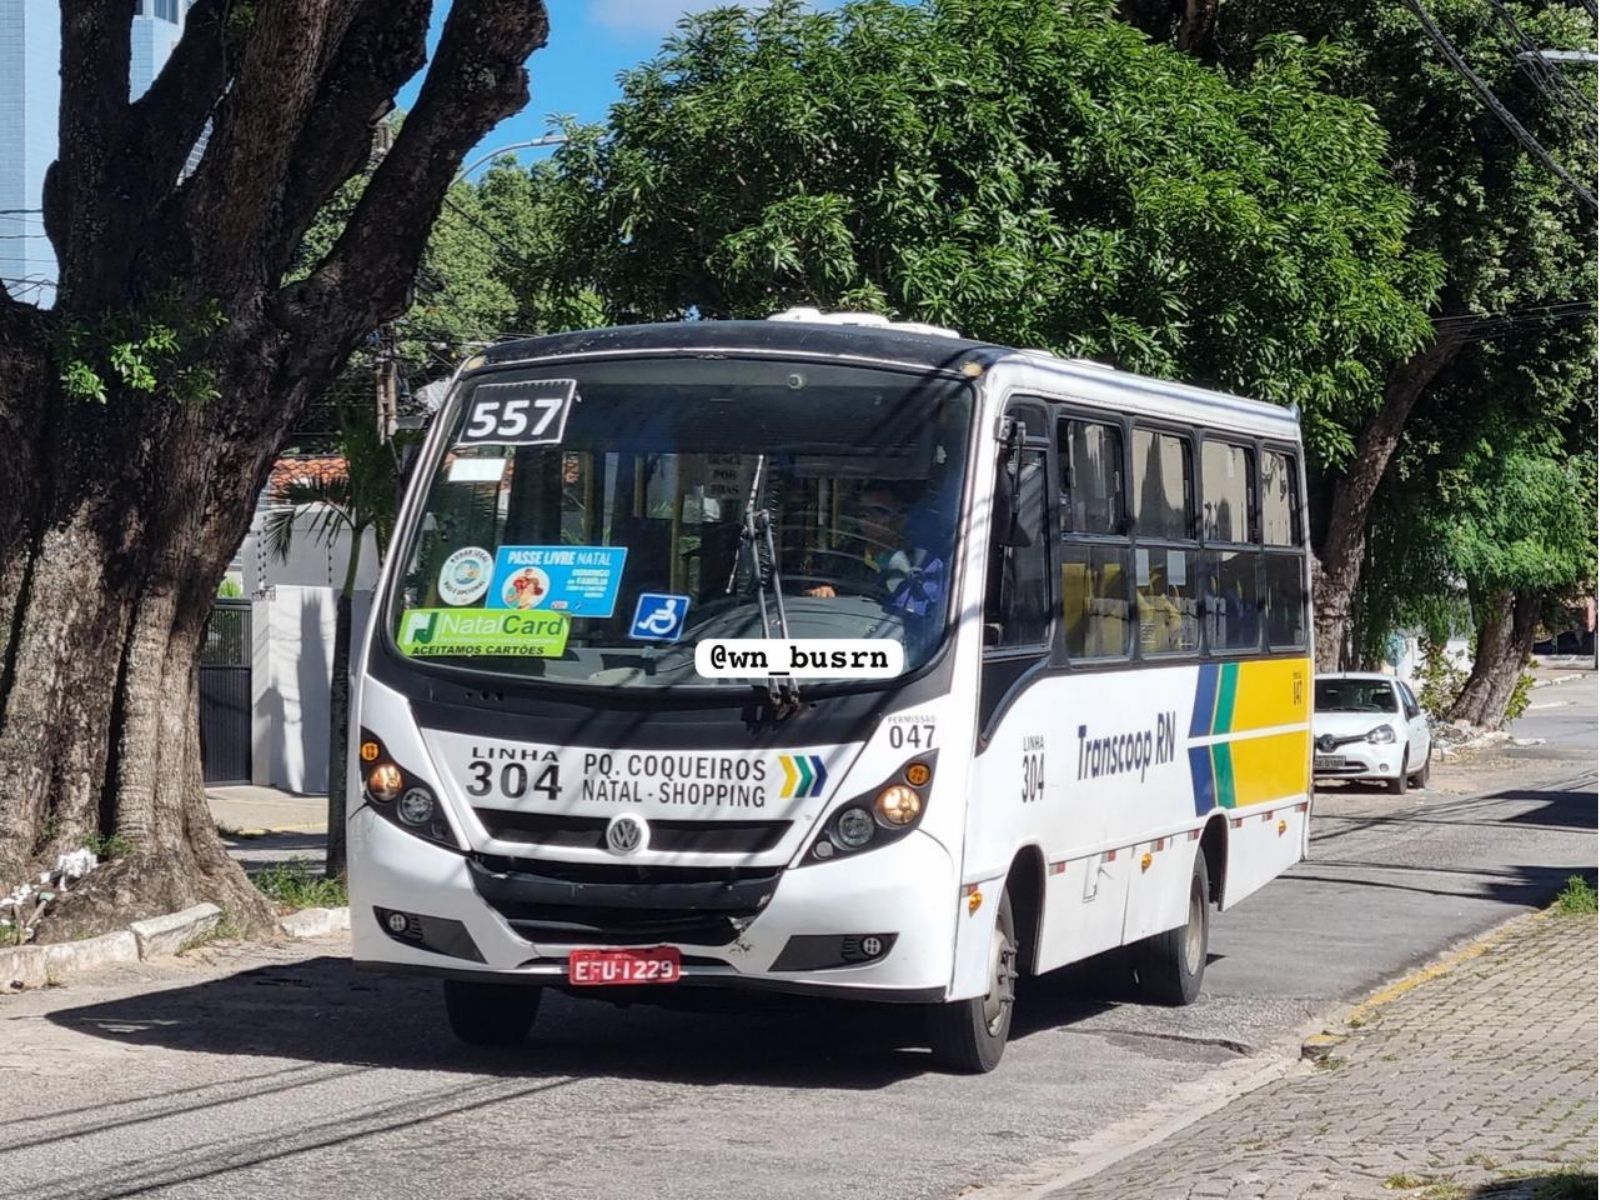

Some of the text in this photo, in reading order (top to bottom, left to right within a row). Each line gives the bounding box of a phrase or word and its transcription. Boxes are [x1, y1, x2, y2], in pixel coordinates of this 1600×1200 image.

[467, 398, 563, 437] 557
[507, 550, 611, 566] PASSE LIVRE NATAL
[441, 614, 564, 636] NatalCard
[412, 644, 545, 655] ACEITAMOS CARTÕES
[889, 724, 936, 749] 047
[1023, 736, 1045, 751] LINHA
[1077, 711, 1176, 784] Transcoop RN
[472, 747, 559, 762] LINHA
[583, 753, 766, 781] PQ. COQUEIROS
[466, 761, 562, 801] 304
[1022, 753, 1045, 803] 304
[582, 779, 642, 803] NATAL
[659, 781, 766, 808] SHOPPING
[575, 960, 673, 980] EFU-1229
